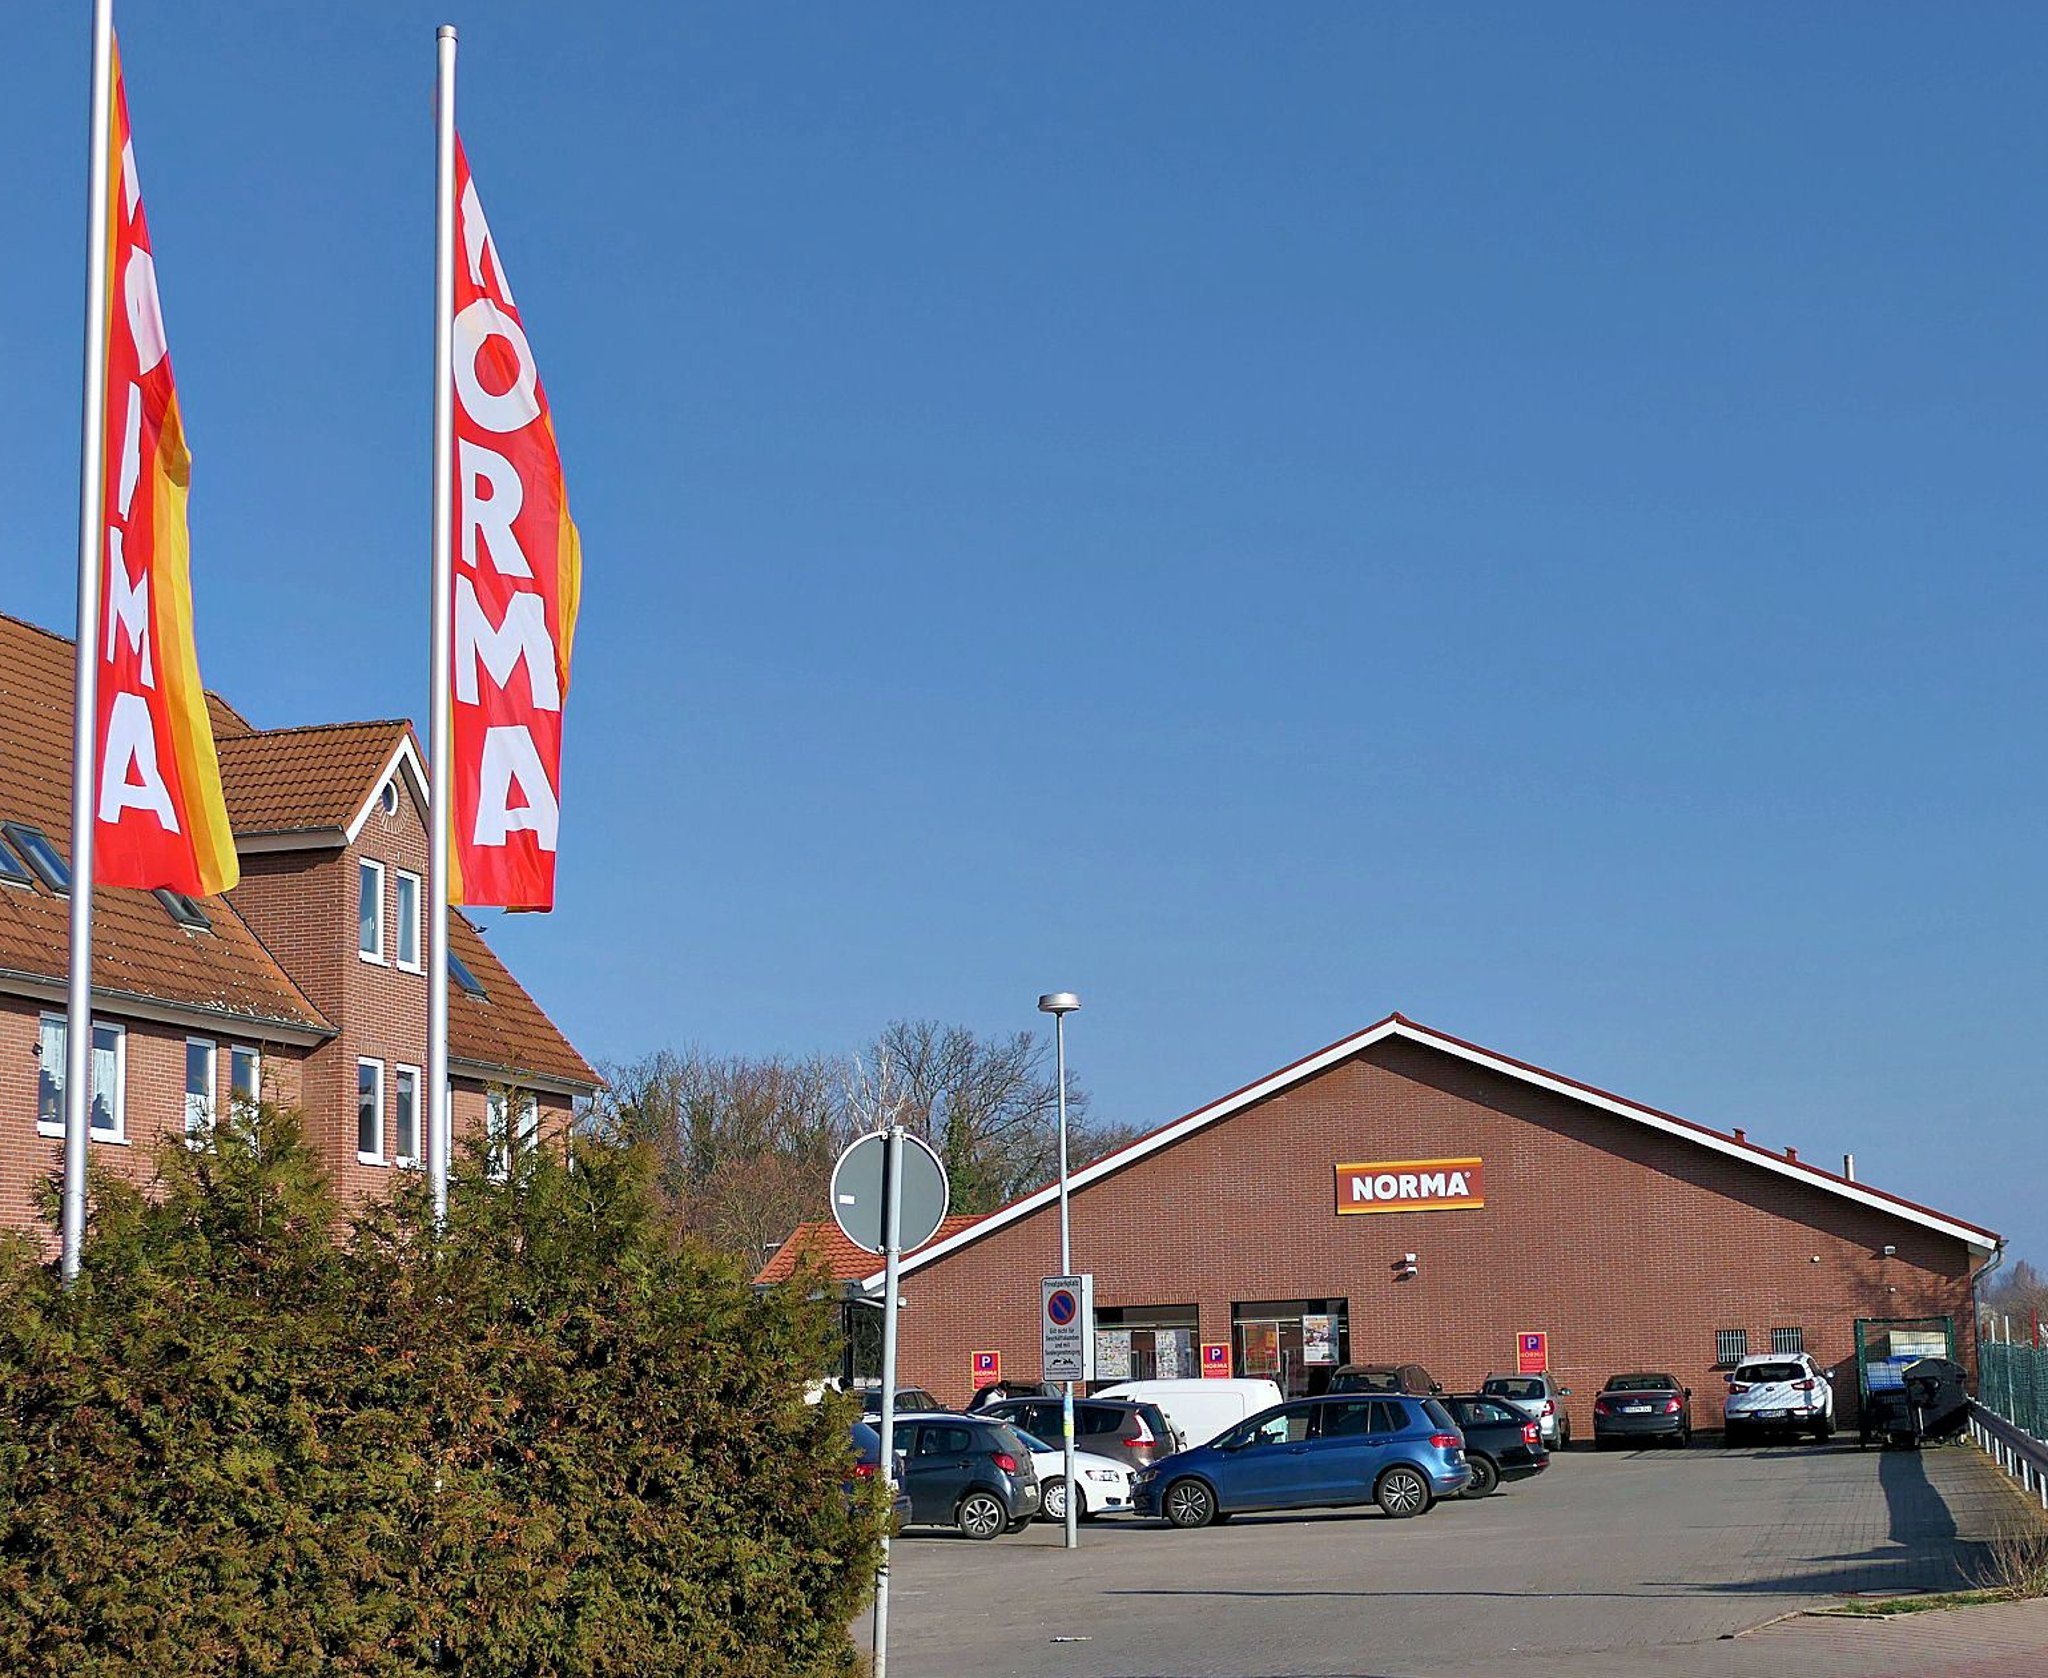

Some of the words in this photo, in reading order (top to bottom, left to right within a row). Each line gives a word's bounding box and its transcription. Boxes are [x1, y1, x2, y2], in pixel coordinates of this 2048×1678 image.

[98, 136, 181, 834] OMA
[1211, 1348, 1221, 1360] P
[981, 1355, 991, 1368] P
